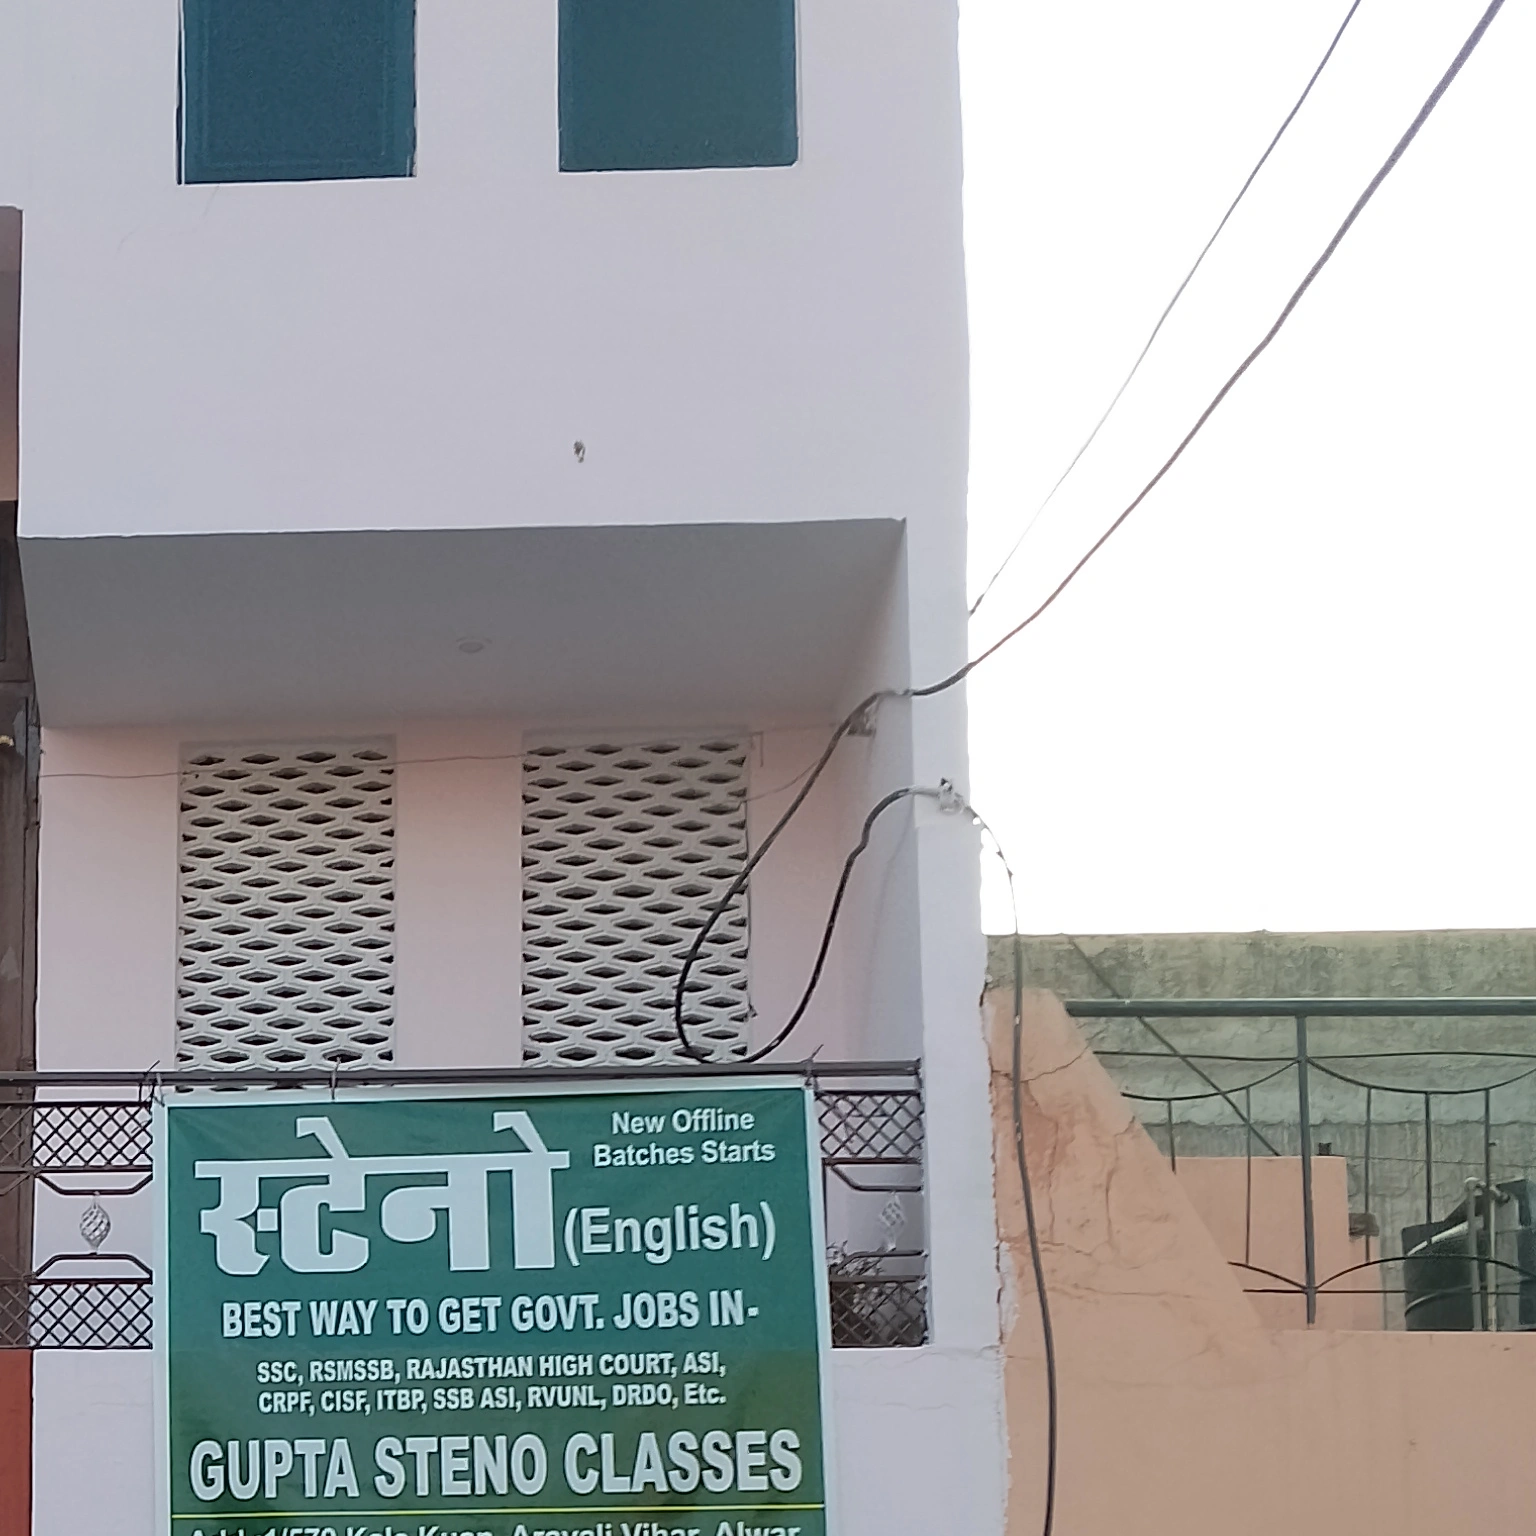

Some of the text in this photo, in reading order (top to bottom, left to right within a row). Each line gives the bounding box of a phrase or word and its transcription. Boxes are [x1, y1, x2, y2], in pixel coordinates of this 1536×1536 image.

[611, 1107, 756, 1135] New Offline
[592, 1139, 776, 1168] Batches Starts
[194, 1110, 570, 1276] स्टेनो
[563, 1200, 776, 1267] (English)
[221, 1289, 760, 1338] BEST WAY TO GET GOVT. JOBS IN-
[256, 1350, 727, 1387] SSC, RSMSSB, RAJASTHAN HIGH COURT, ASI,
[257, 1382, 727, 1418] CRPF, CISF, ITBP, SSB ASI, RVUNL, DRDO, Etc.
[189, 1428, 803, 1501] GUPTA STENO CLASSES
